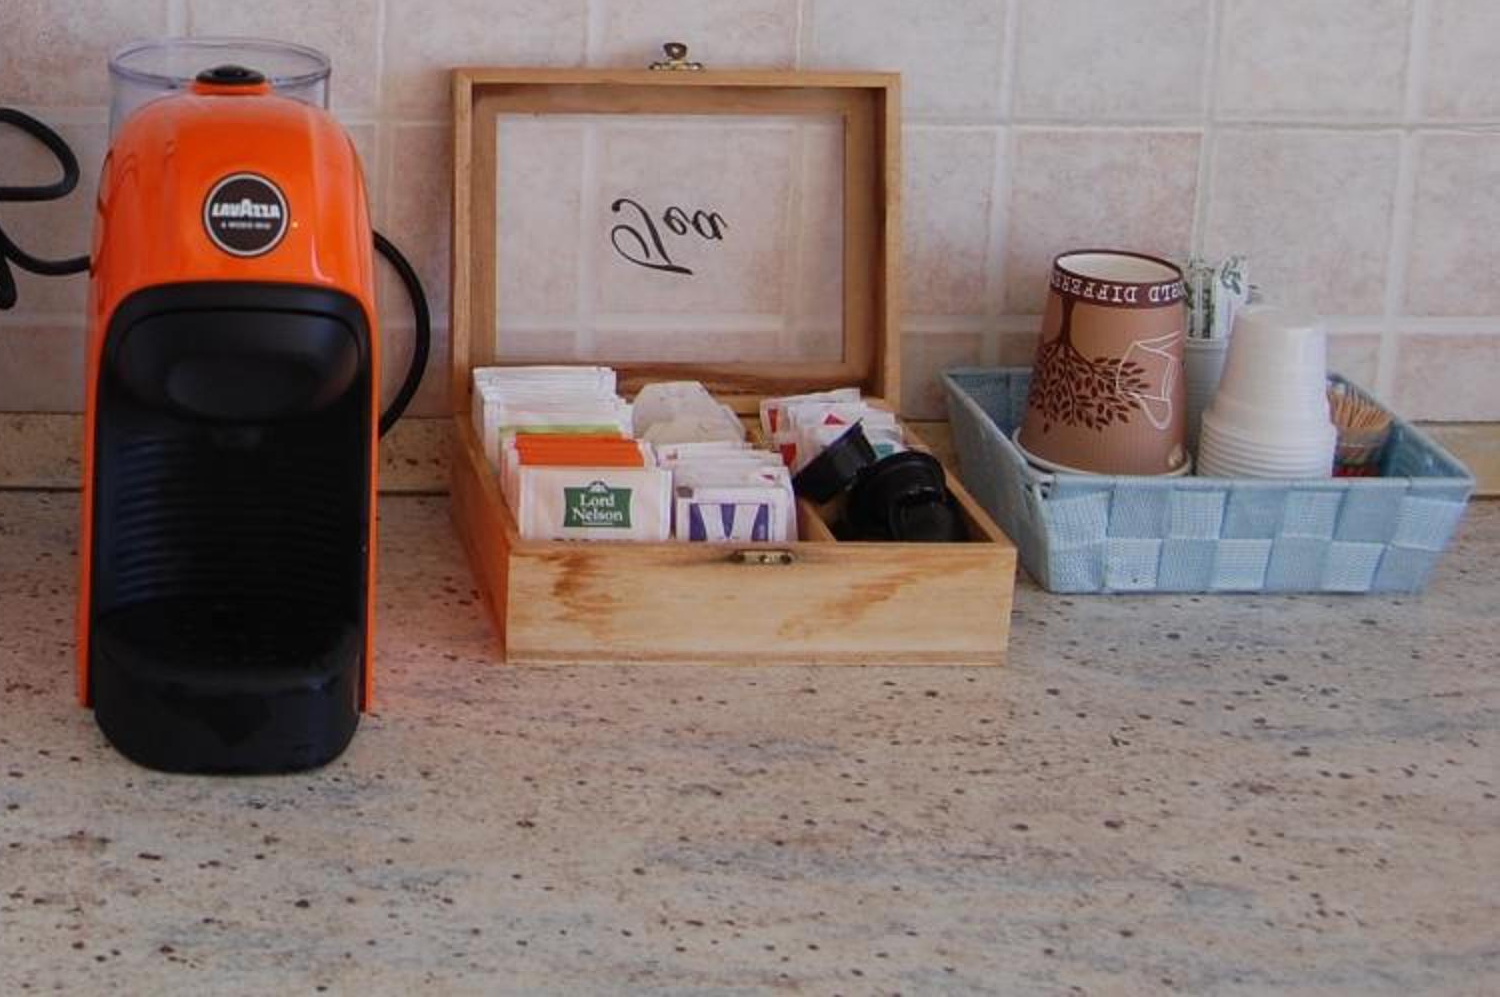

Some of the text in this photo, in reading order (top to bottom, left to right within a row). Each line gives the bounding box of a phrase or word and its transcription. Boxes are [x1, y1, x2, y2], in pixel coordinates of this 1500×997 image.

[211, 198, 281, 219] LAVAZZA
[580, 493, 615, 507] Lord
[572, 507, 623, 523] Nelson
